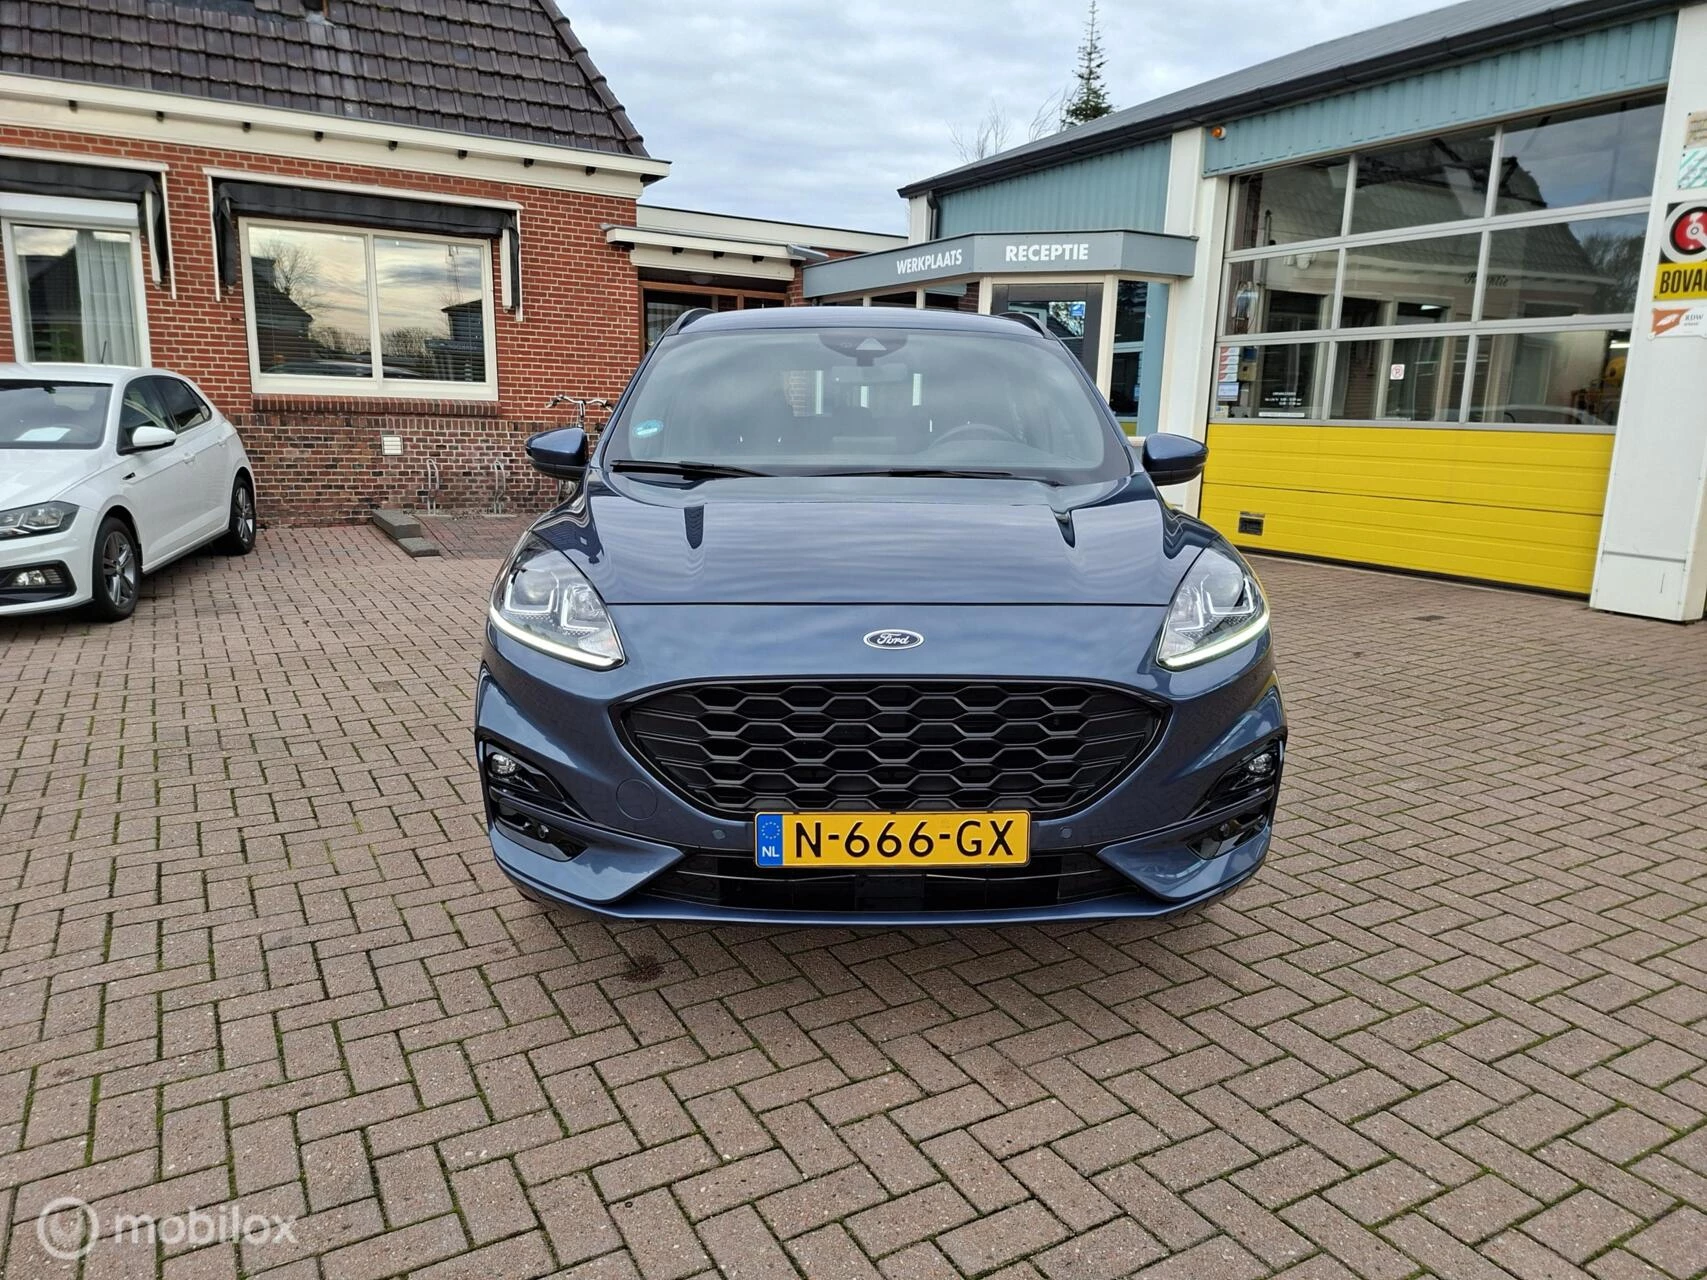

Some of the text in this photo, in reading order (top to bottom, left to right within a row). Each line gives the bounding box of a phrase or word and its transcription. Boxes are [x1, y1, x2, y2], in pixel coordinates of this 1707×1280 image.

[896, 248, 962, 275] WERKPLAATS
[1005, 243, 1089, 262] RECEPTIE
[876, 632, 910, 646] Ford
[794, 819, 1015, 858] N-666-GX
[761, 845, 780, 858] NL
